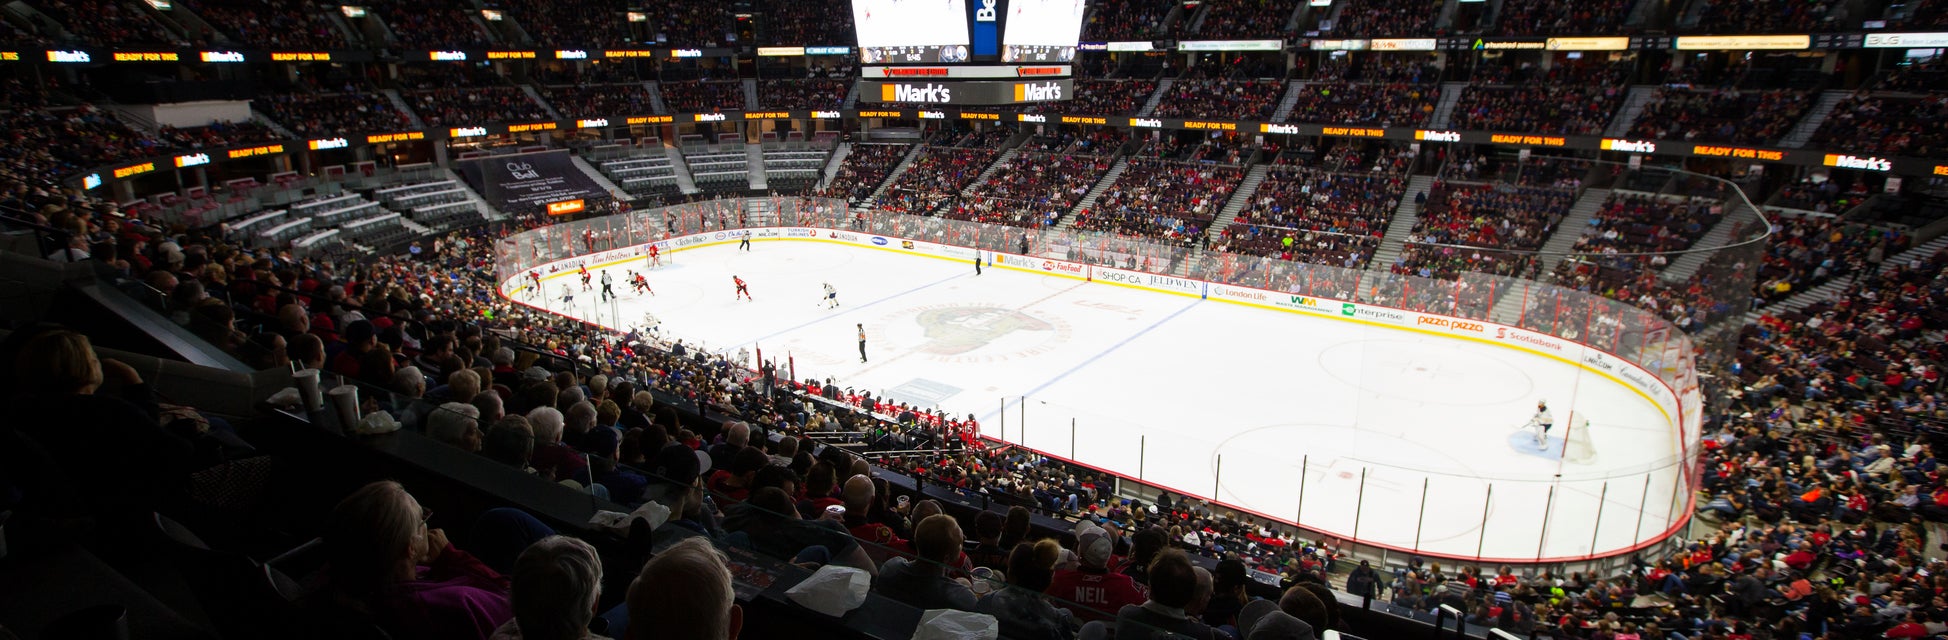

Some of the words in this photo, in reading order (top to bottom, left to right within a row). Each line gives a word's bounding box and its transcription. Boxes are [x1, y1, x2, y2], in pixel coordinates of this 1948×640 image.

[976, 0, 996, 22] Be
[561, 50, 586, 59] Mark's
[677, 49, 702, 57] Mark's
[875, 50, 882, 60] 2
[945, 48, 952, 60] 4
[1014, 49, 1020, 59] 2
[1061, 48, 1066, 58] 4
[895, 83, 950, 102] Mark's
[1024, 82, 1061, 102] Mark's
[701, 113, 725, 122] Mark's
[817, 110, 840, 118] Mark's
[924, 111, 944, 119] Mark's
[1024, 114, 1045, 122] Mark's
[509, 124, 530, 132] READY
[583, 118, 608, 128] Mark's
[1136, 118, 1162, 128] Mark's
[1221, 122, 1236, 130] THIS
[458, 127, 486, 136] Mark's
[1268, 124, 1298, 134] Mark's
[1323, 128, 1348, 136] READY
[1350, 128, 1365, 136] FOR
[1367, 128, 1384, 138] THIS
[368, 134, 392, 142] READY
[393, 132, 408, 140] FOR
[409, 132, 423, 140] THIS
[1424, 130, 1460, 142] Mark's
[1492, 134, 1522, 144] READY
[1524, 136, 1542, 144] FOR
[1544, 136, 1564, 146] THIS
[317, 138, 348, 149] Mark's
[1611, 140, 1655, 152] Mark's
[1694, 146, 1731, 156] READY
[1733, 148, 1756, 158] FOR
[1758, 150, 1782, 160] THIS
[506, 162, 532, 172] Club
[1836, 156, 1891, 171] Mark's
[512, 170, 540, 180] Bell
[592, 255, 604, 264] Tim
[606, 252, 631, 262] Hortons
[1004, 256, 1036, 268] Mark's
[556, 260, 586, 271] CANADIAN
[1102, 271, 1126, 282] SHOP
[1128, 274, 1141, 284] CA
[1226, 289, 1252, 300] London
[1253, 292, 1267, 301] Life
[1291, 296, 1316, 306] WM
[1417, 315, 1448, 327] pizza
[1450, 320, 1484, 333] pizza
[1510, 331, 1563, 351] Scotiabank
[1075, 586, 1108, 604] NEIL
